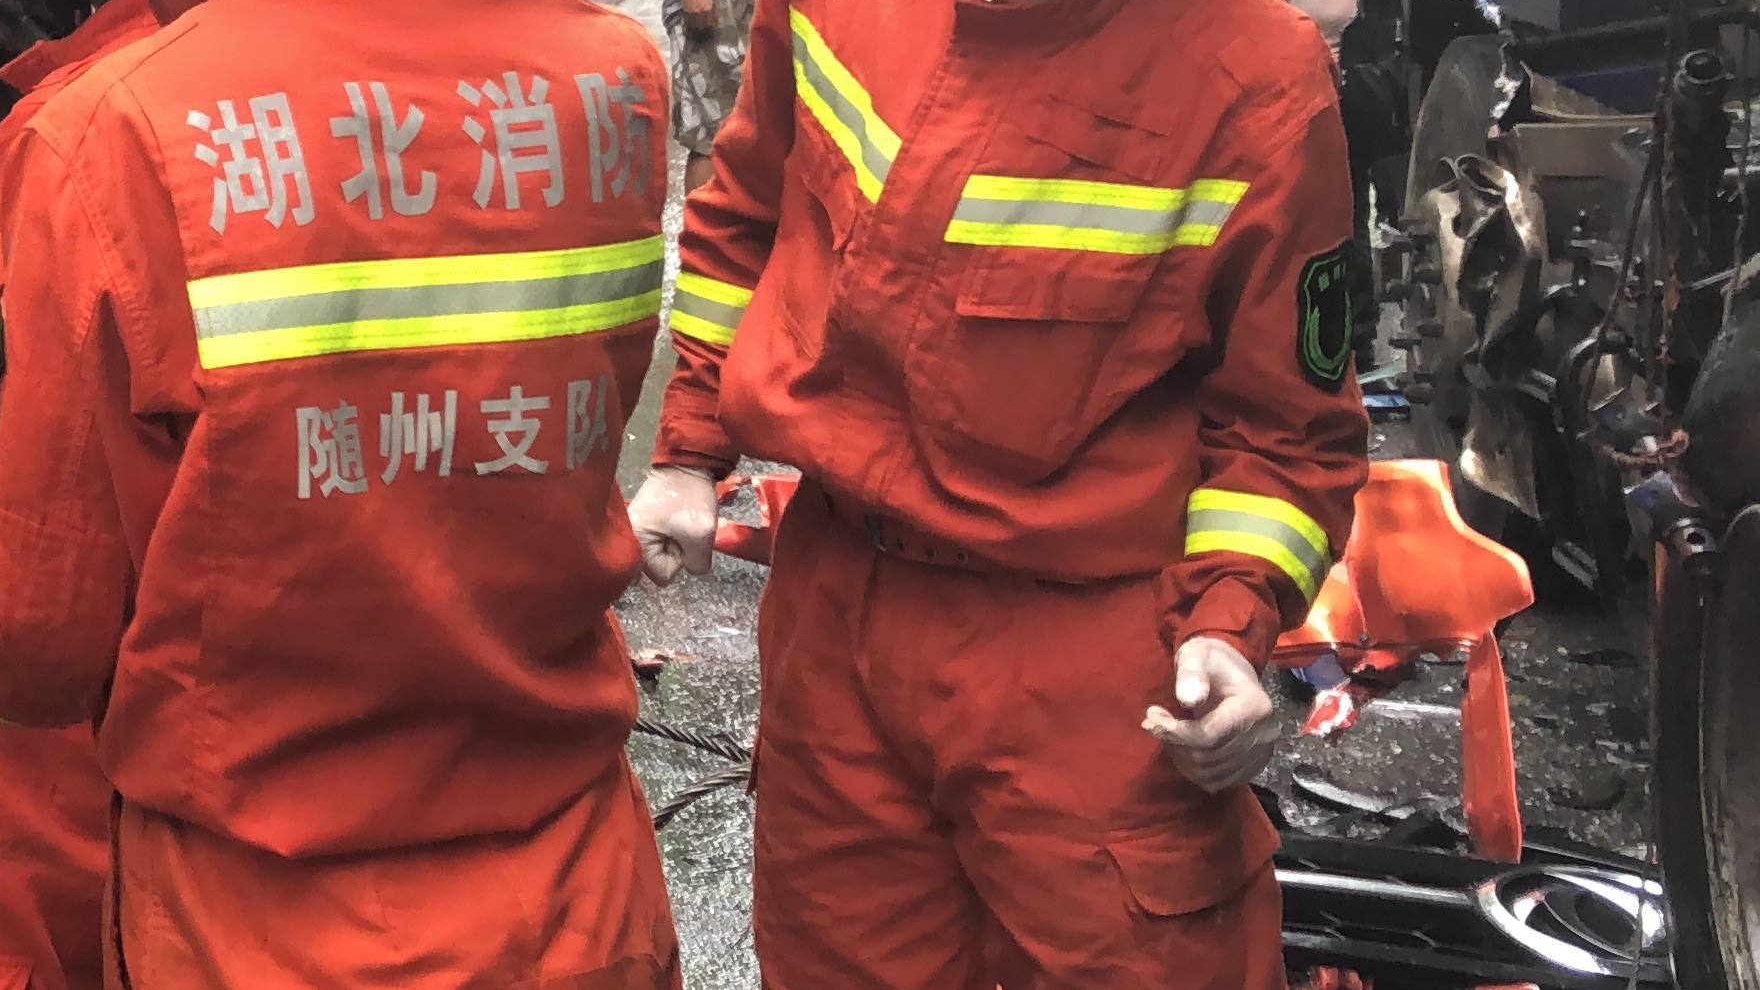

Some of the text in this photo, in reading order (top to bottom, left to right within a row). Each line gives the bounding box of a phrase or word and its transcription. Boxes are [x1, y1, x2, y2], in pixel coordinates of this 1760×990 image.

[186, 65, 648, 236] 湖北消防
[295, 375, 609, 499] 随州支队
